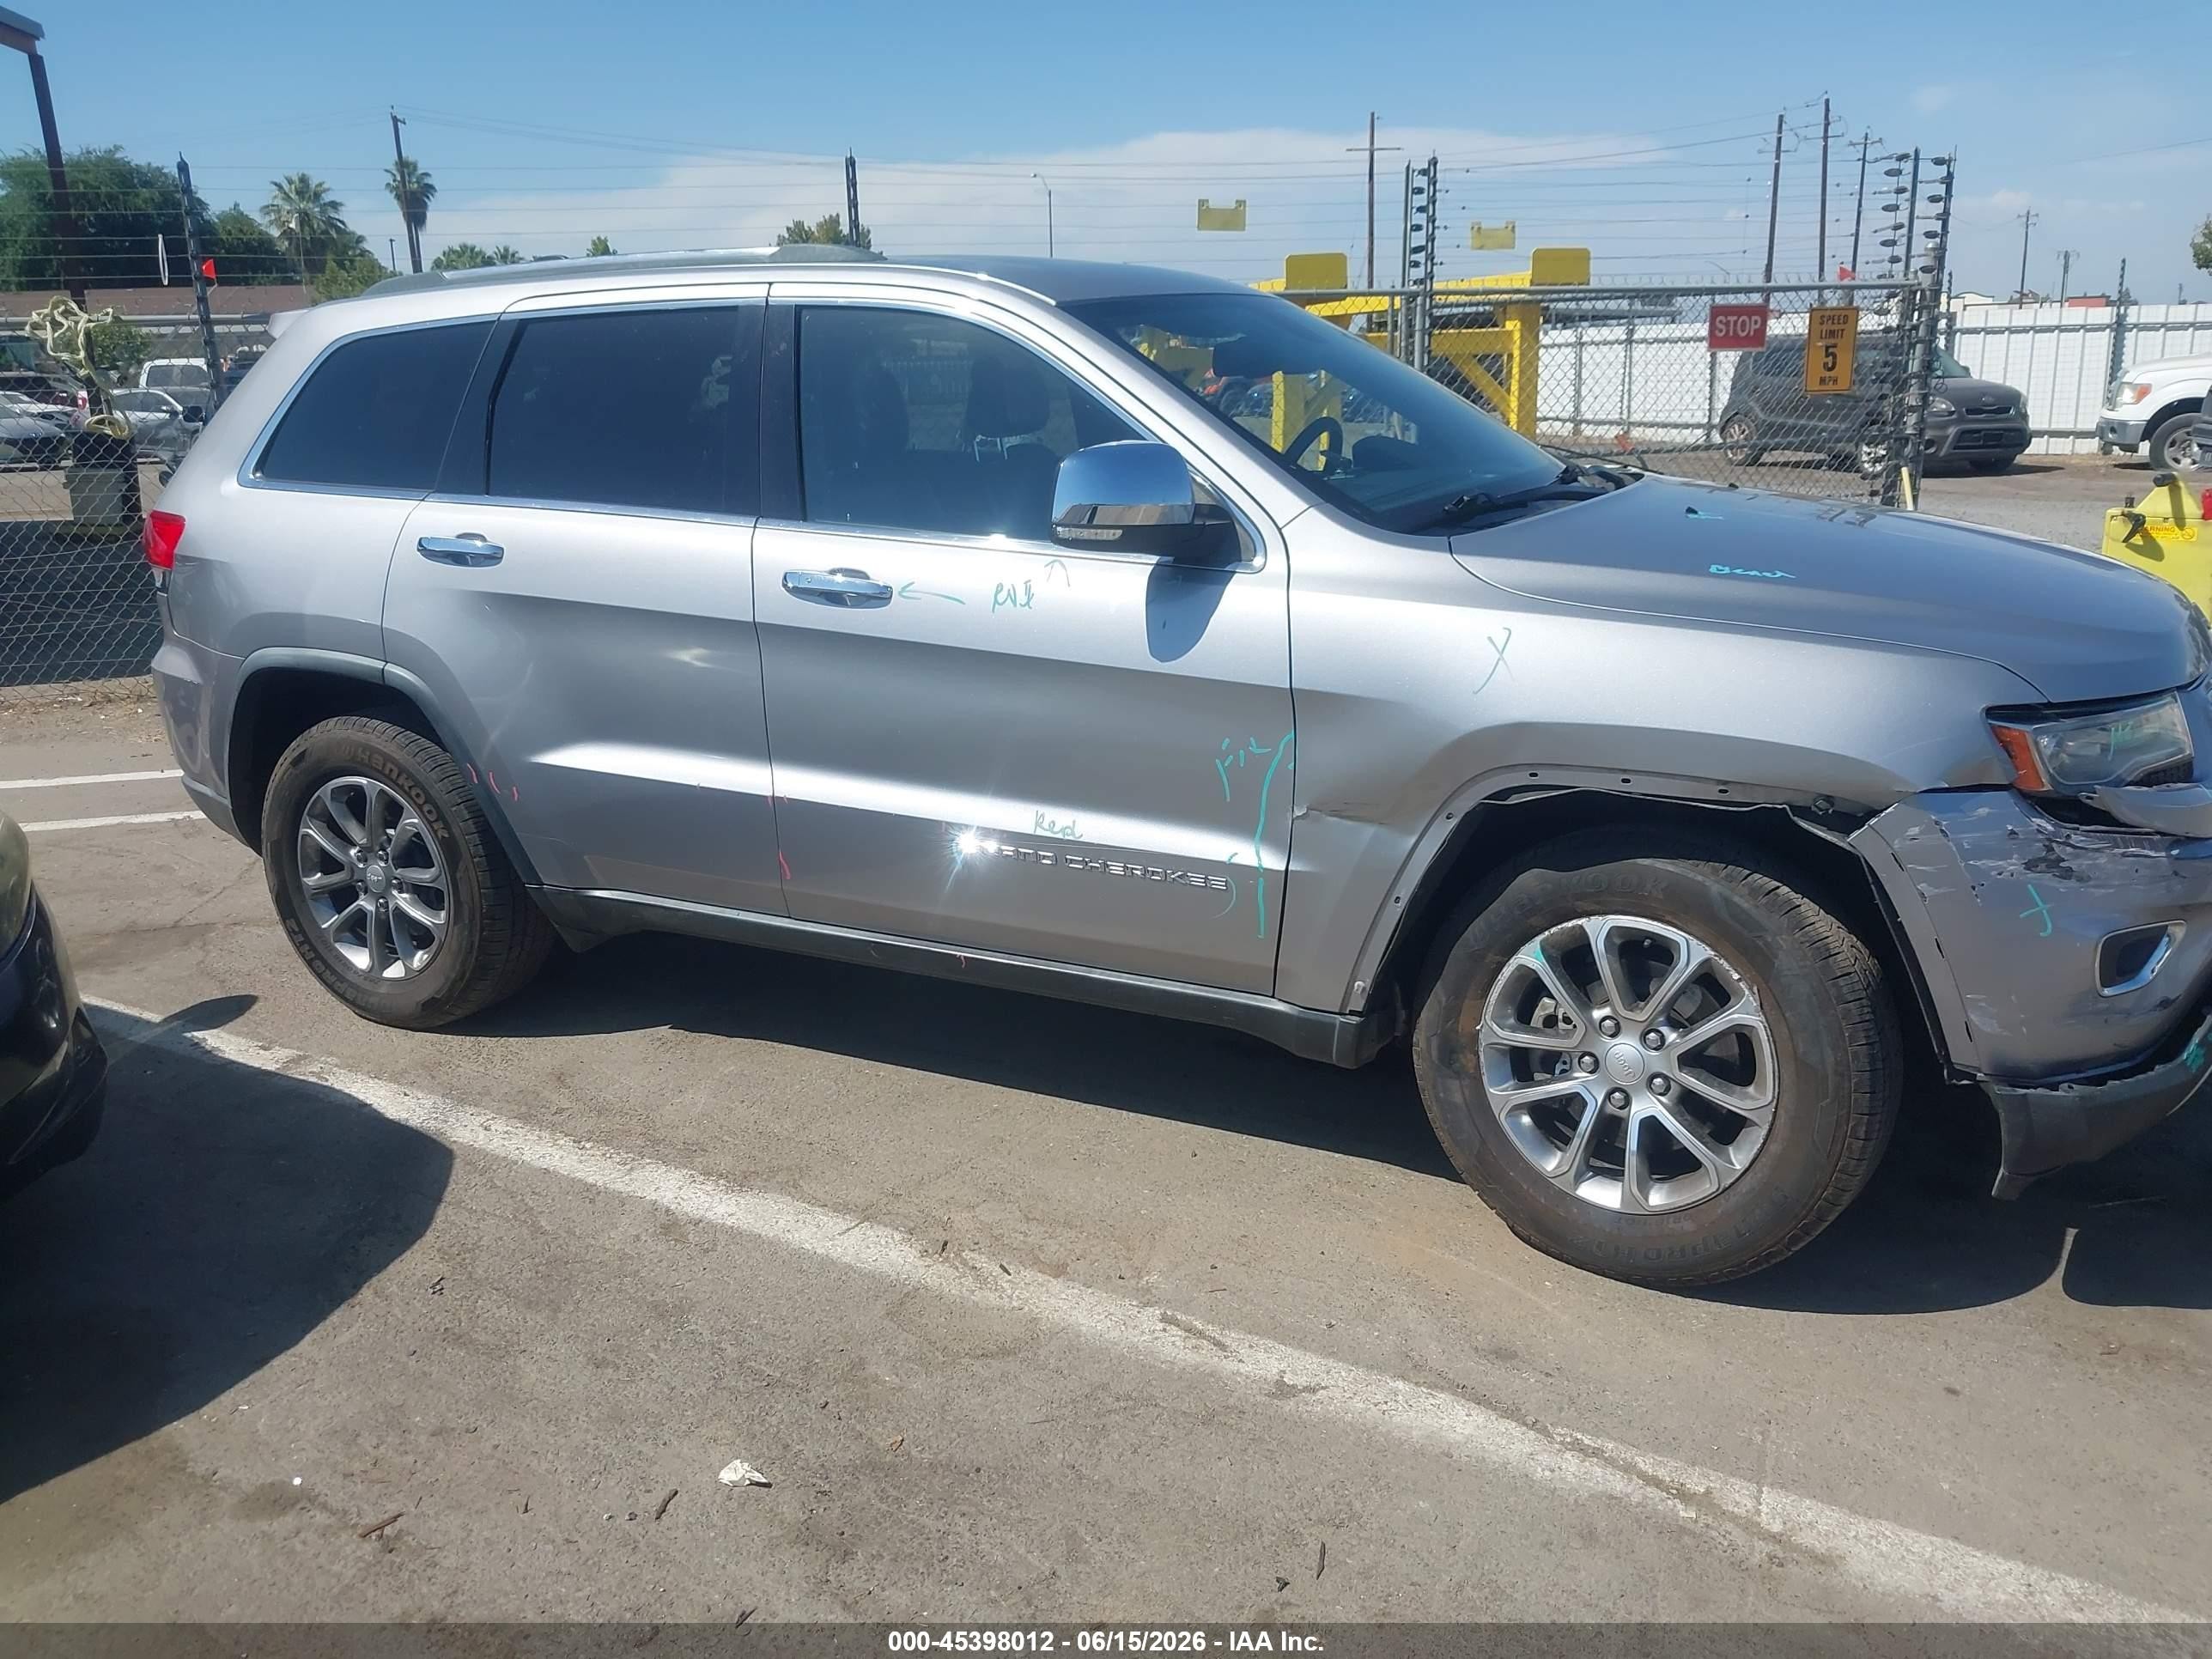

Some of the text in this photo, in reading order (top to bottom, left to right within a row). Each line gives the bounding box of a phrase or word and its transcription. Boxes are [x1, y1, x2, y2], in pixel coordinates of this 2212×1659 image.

[1715, 315, 1760, 337] STOP
[1819, 314, 1849, 325] SPEED
[1819, 329, 1846, 340] LIMIT
[1822, 343, 1838, 373] 5
[1819, 375, 1839, 386] MPH
[1064, 854, 1228, 890] CHEROKEE
